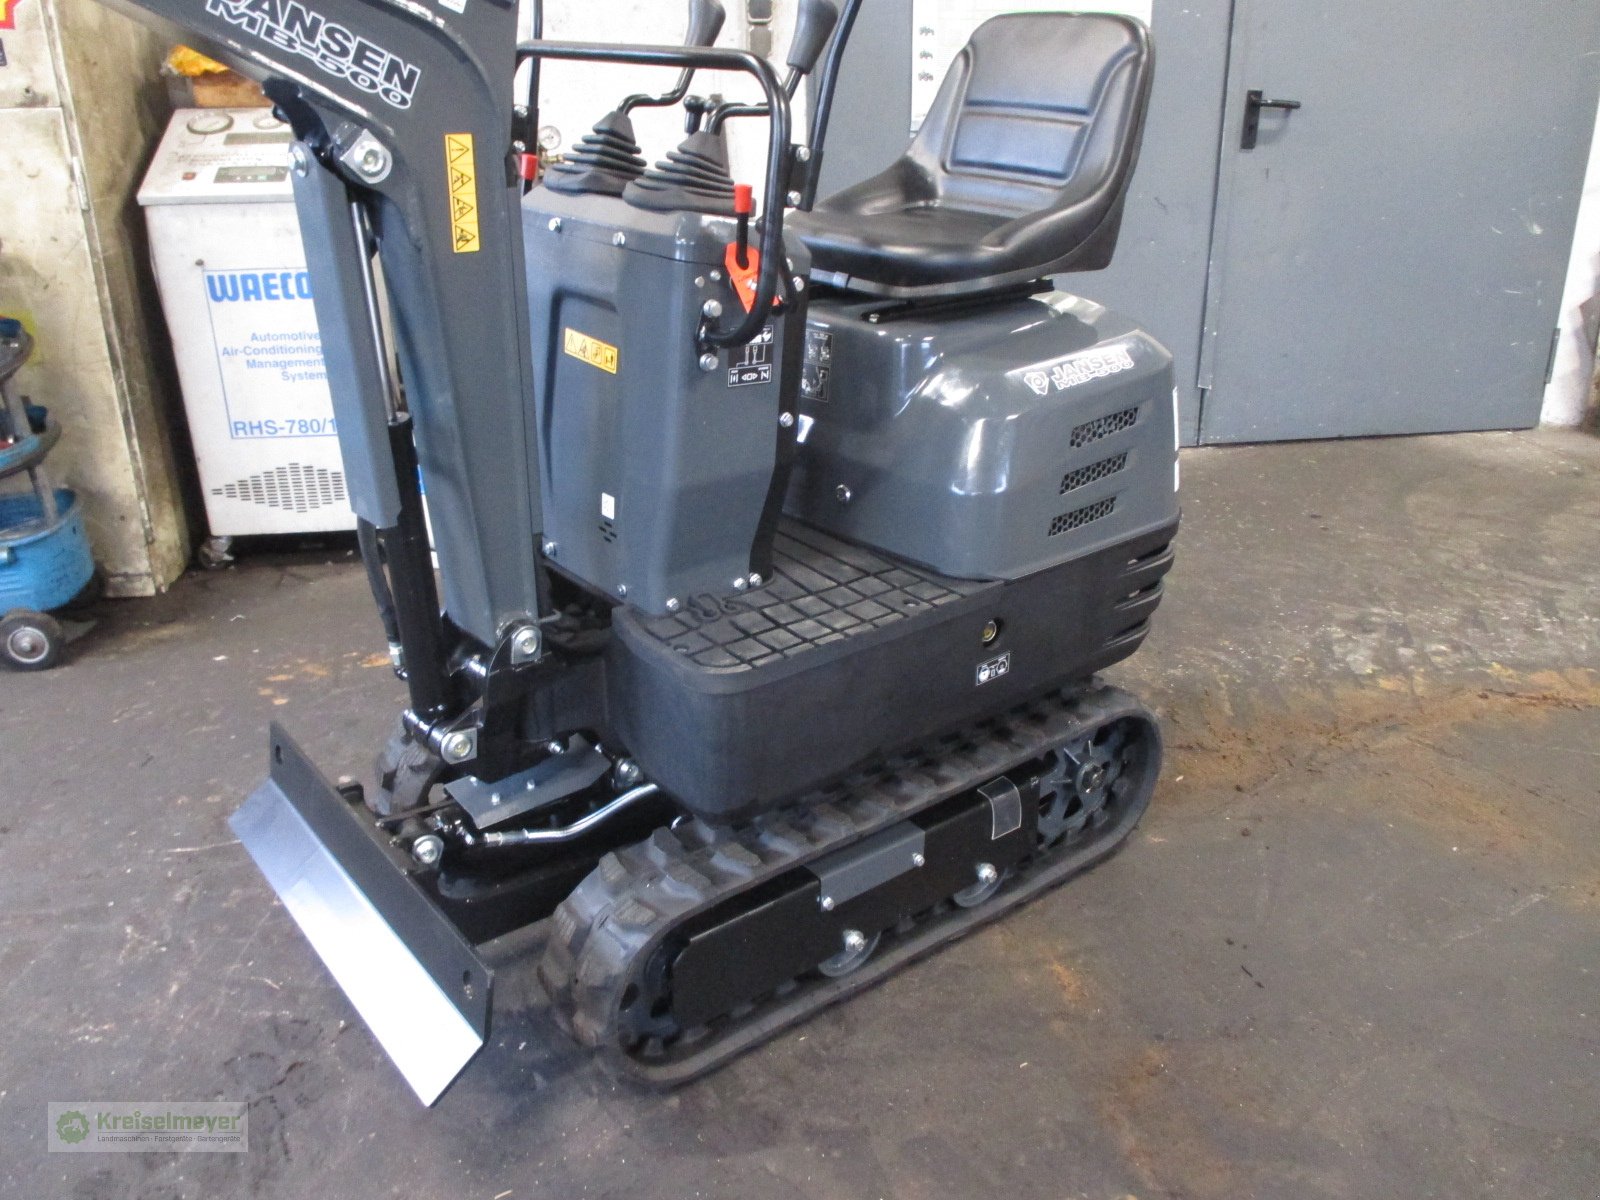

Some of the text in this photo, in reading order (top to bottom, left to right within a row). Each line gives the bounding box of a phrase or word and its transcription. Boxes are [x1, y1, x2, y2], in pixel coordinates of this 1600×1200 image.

[222, 0, 422, 98] ANSEN
[206, 271, 314, 303] WAECO
[250, 331, 321, 341] Automotive
[221, 344, 323, 357] Air-Conditioning
[246, 358, 325, 370] Management
[1051, 350, 1130, 382] JANSEN
[281, 370, 327, 382] System
